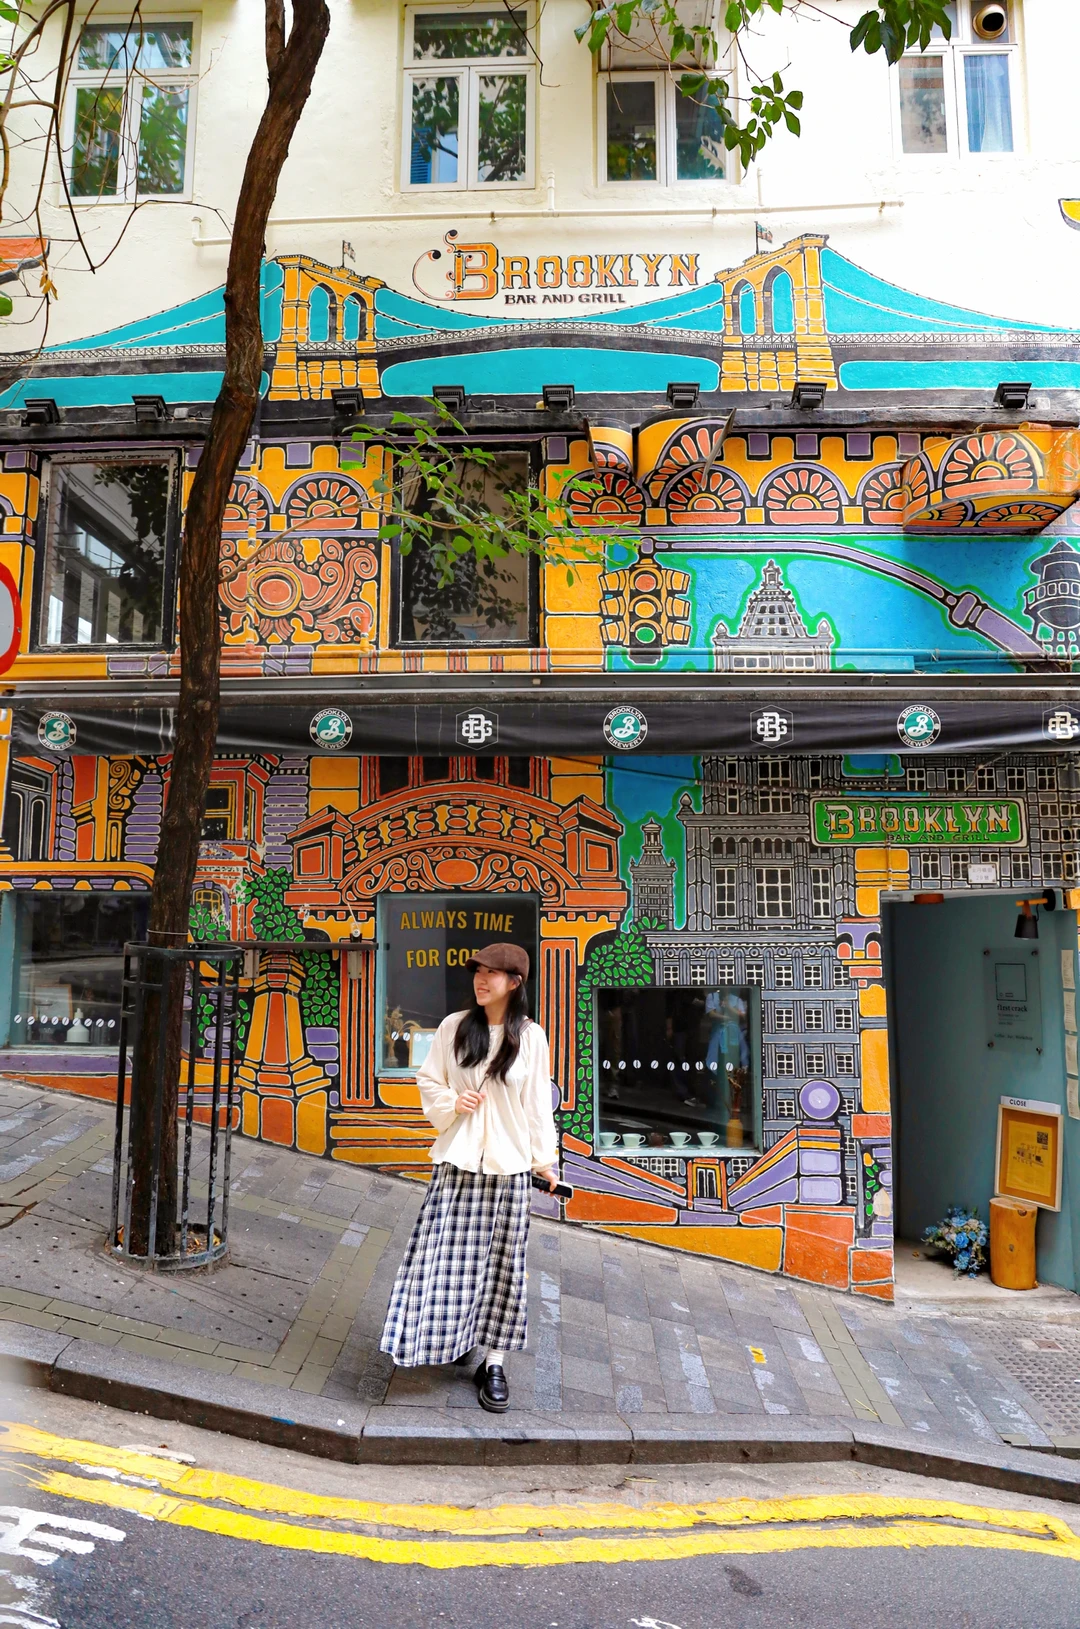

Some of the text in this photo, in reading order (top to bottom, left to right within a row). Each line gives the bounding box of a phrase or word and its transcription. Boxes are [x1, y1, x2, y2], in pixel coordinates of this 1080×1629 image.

[446, 240, 700, 300] BROOKLYN
[504, 293, 627, 305] BAR AND GRILL
[313, 708, 350, 722] BROOKLYN
[607, 706, 643, 720] BROOKLYN
[901, 705, 937, 719] BROOKLYN
[314, 737, 349, 750] BREWERY
[608, 736, 643, 749] BREWERY
[902, 734, 936, 747] BREWERY
[824, 803, 1012, 841] BROOKLYN
[887, 833, 990, 842] BAR AND GRILL
[400, 911, 515, 933] ALWAYS TIME
[406, 948, 440, 968] FOR
[1009, 1099, 1027, 1107] CLOSE
